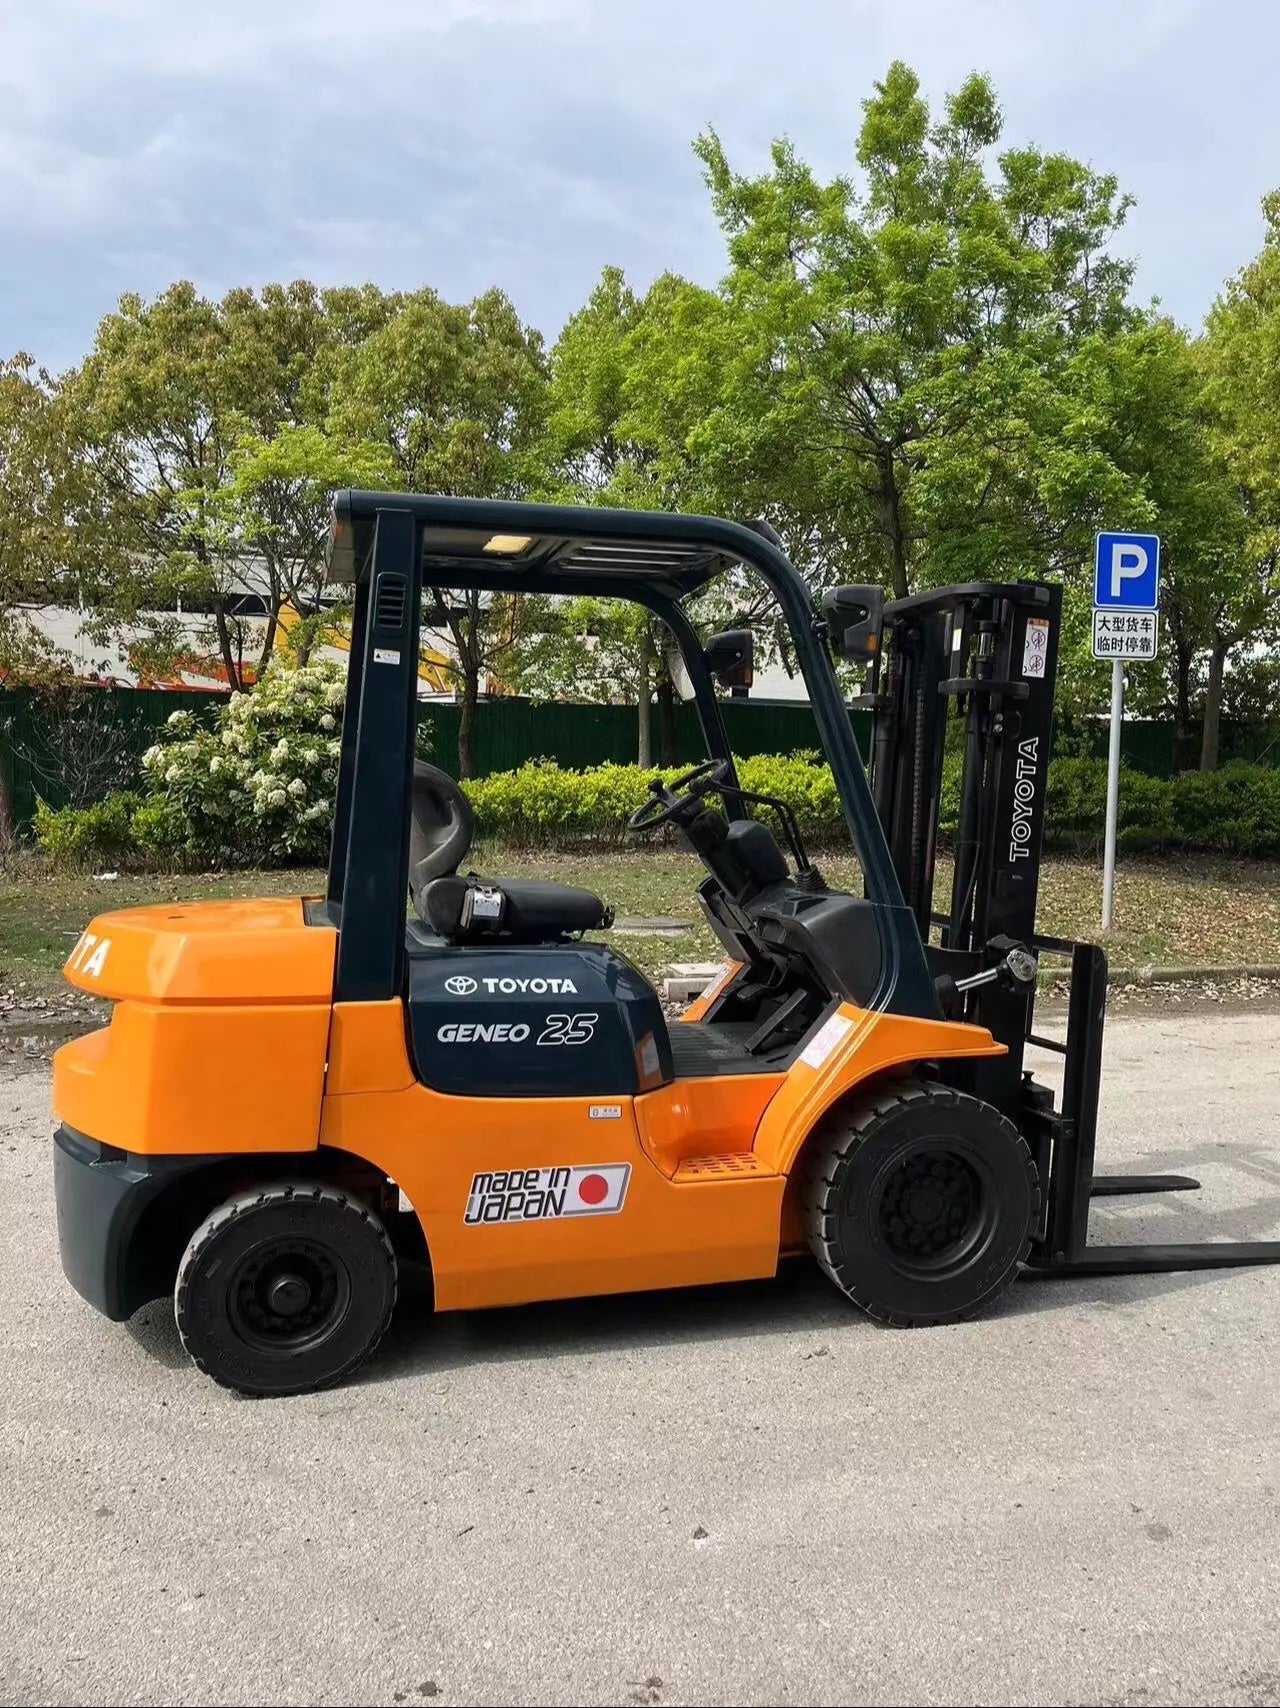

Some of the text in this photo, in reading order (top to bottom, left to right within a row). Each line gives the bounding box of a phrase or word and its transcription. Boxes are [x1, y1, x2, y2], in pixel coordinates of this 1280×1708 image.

[1111, 543, 1148, 597] P
[1098, 616, 1152, 632] 大型货车
[1097, 636, 1152, 653] 临时停靠
[1009, 736, 1039, 862] TOYOTA
[482, 978, 578, 994] TOYOTA
[437, 1013, 599, 1046] GENEO 25
[548, 1167, 571, 1189] in
